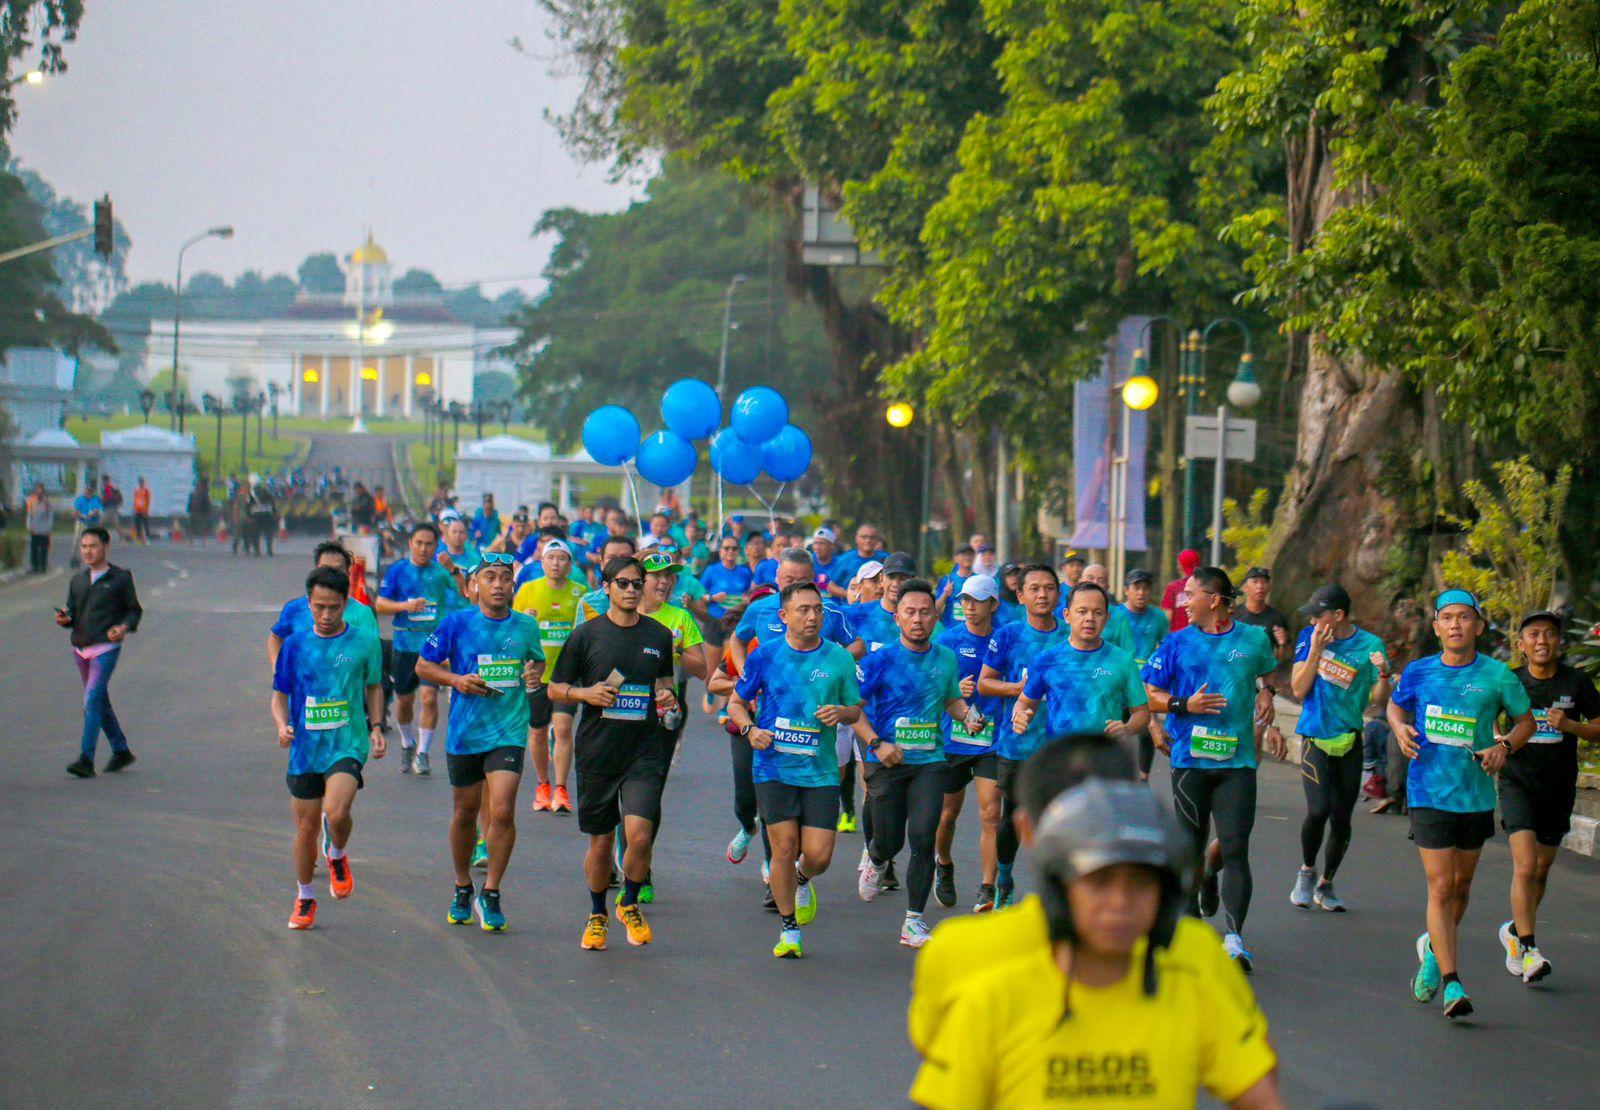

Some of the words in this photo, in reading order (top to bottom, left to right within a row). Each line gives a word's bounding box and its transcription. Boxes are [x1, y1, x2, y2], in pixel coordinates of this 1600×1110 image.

[479, 666, 513, 677] M2239
[611, 698, 641, 709] 1069
[306, 708, 340, 719] M1015
[1426, 719, 1465, 734] M2646
[775, 730, 812, 744] M2657
[896, 729, 930, 740] M2640
[1202, 740, 1227, 752] 2831
